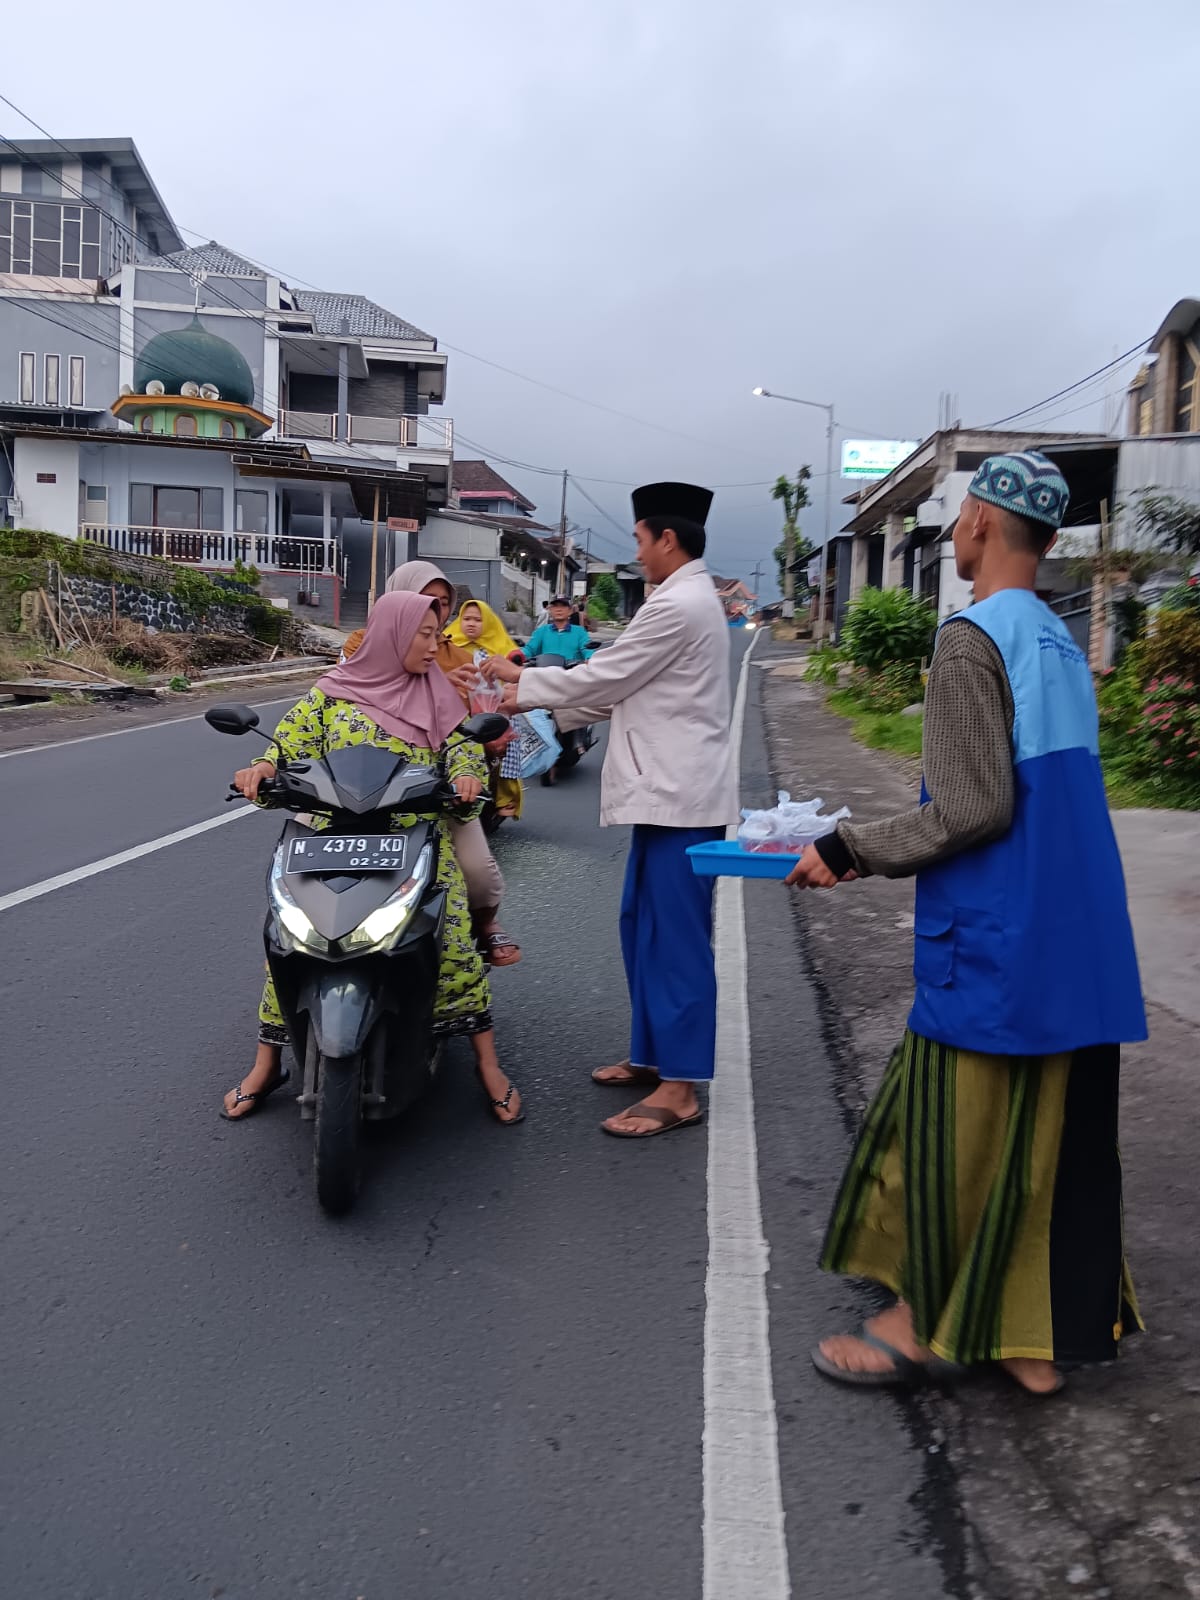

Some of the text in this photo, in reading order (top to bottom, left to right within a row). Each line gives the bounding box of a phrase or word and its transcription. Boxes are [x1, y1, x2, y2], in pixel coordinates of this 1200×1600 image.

[294, 838, 402, 854] N 4379 KD
